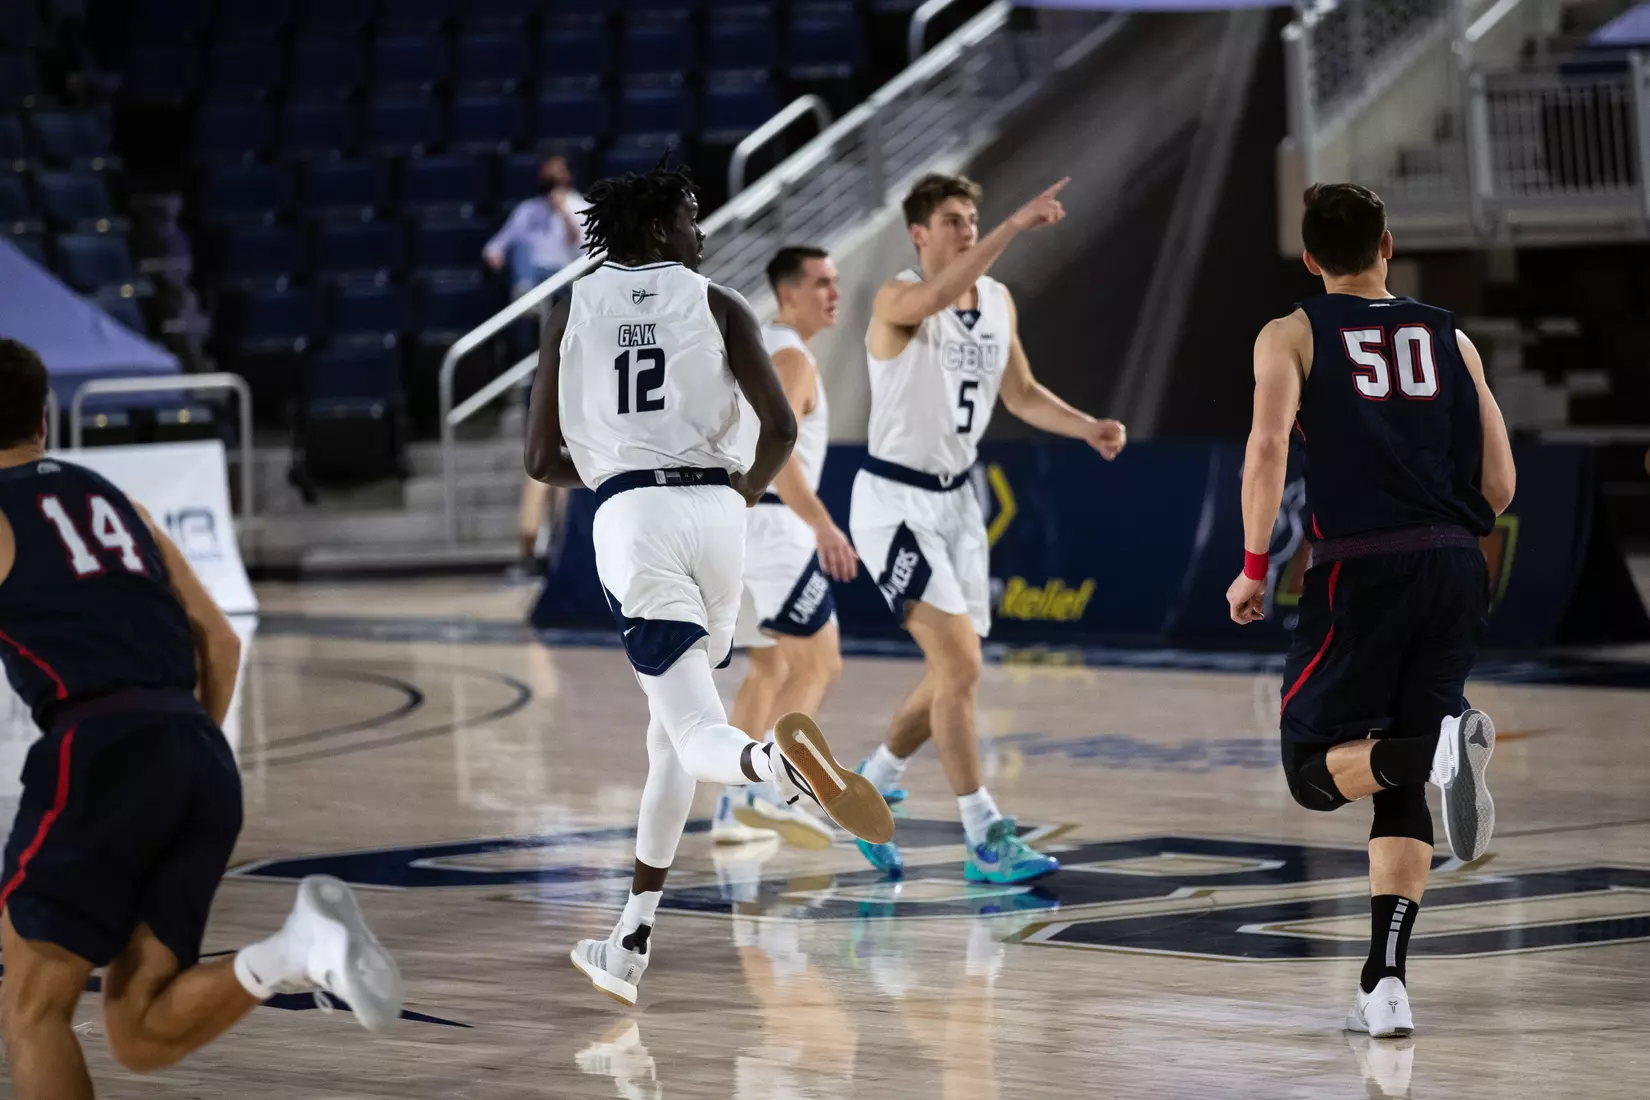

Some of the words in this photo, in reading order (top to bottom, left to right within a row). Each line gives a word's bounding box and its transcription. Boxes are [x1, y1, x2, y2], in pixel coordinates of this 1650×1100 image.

[617, 323, 657, 347] GAK
[941, 340, 999, 374] CBU
[1340, 323, 1440, 401] 50
[614, 347, 666, 414] 12
[955, 380, 979, 434] 5
[37, 493, 149, 580] 14
